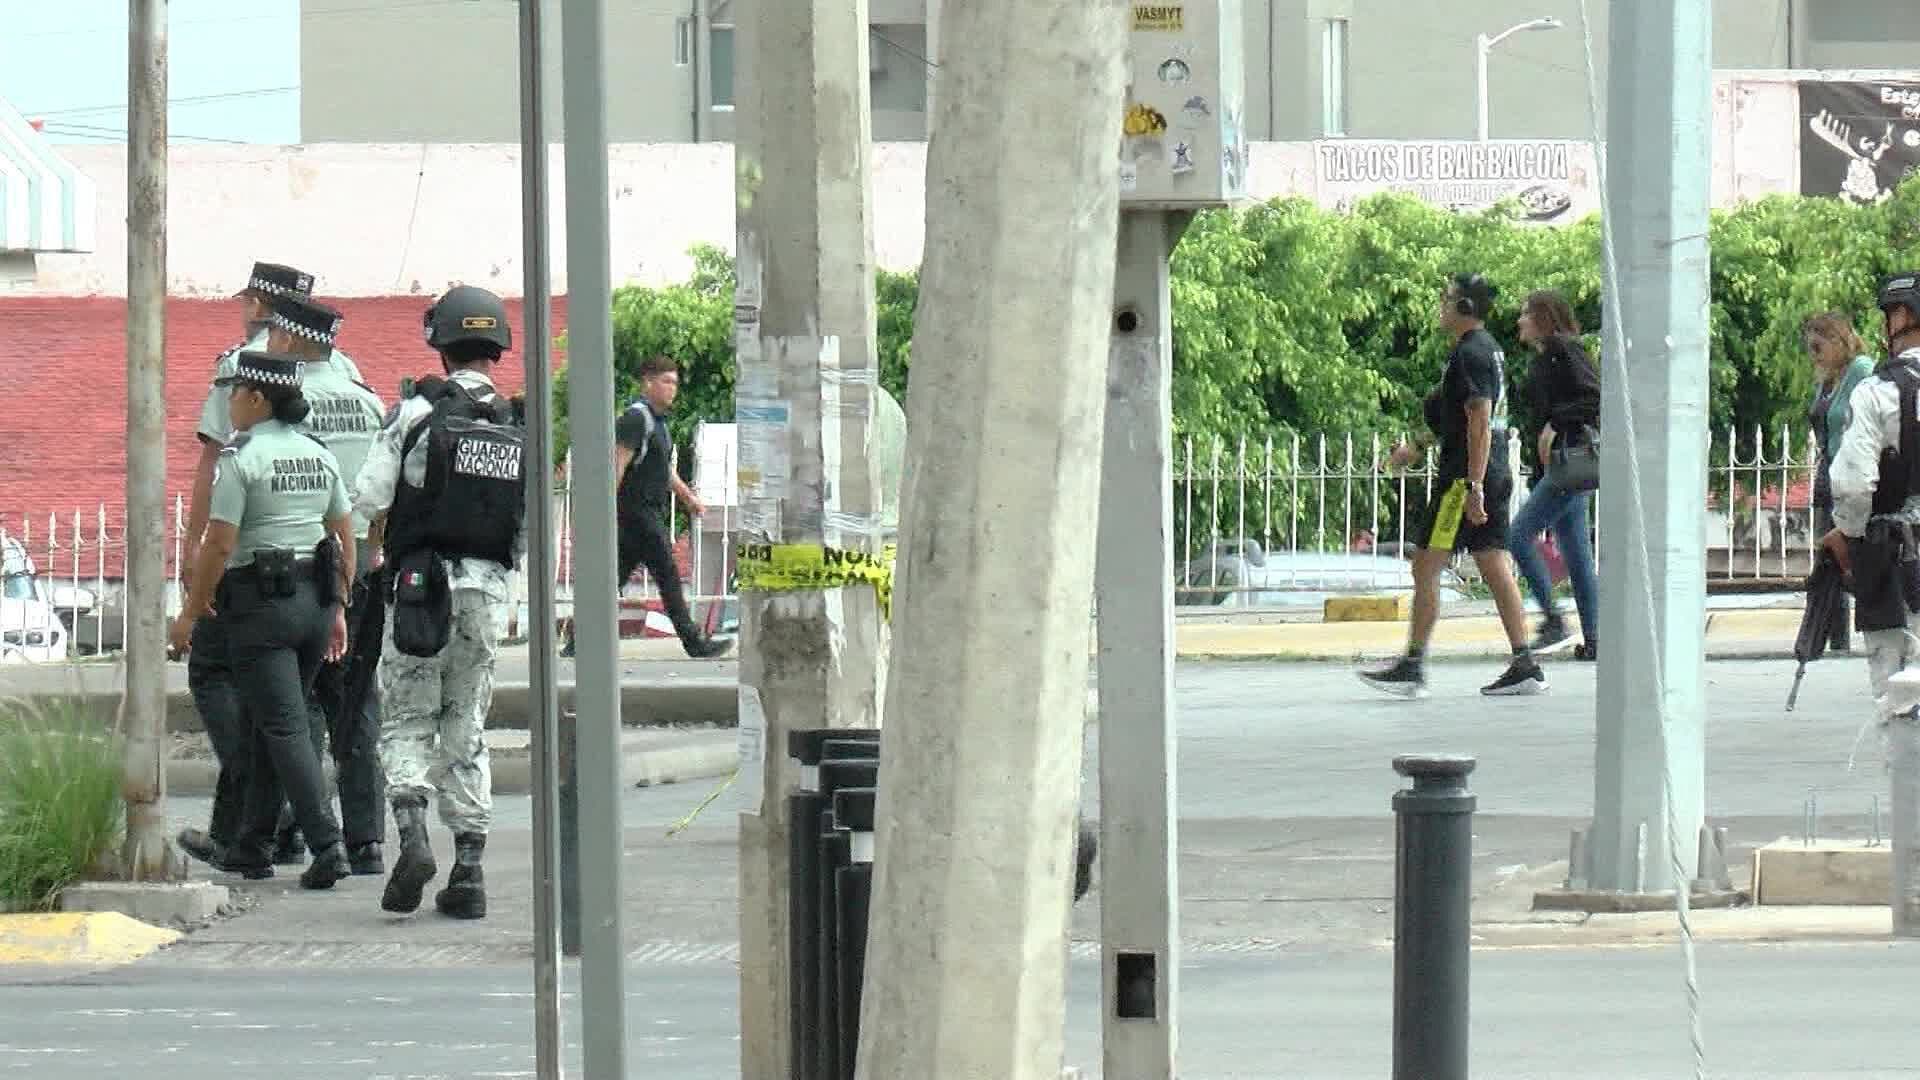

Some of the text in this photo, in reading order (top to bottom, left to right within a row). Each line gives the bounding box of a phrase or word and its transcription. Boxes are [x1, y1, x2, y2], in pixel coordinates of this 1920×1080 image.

[1321, 144, 1568, 182] TACOS DE BARBACOA
[312, 399, 363, 415] GUARDIA
[312, 415, 367, 432] NACIONAL
[458, 439, 521, 461] GUARDIA
[273, 457, 323, 474] GUARDIA
[456, 454, 519, 479] NACIONAL
[271, 475, 327, 491] NACIONAL
